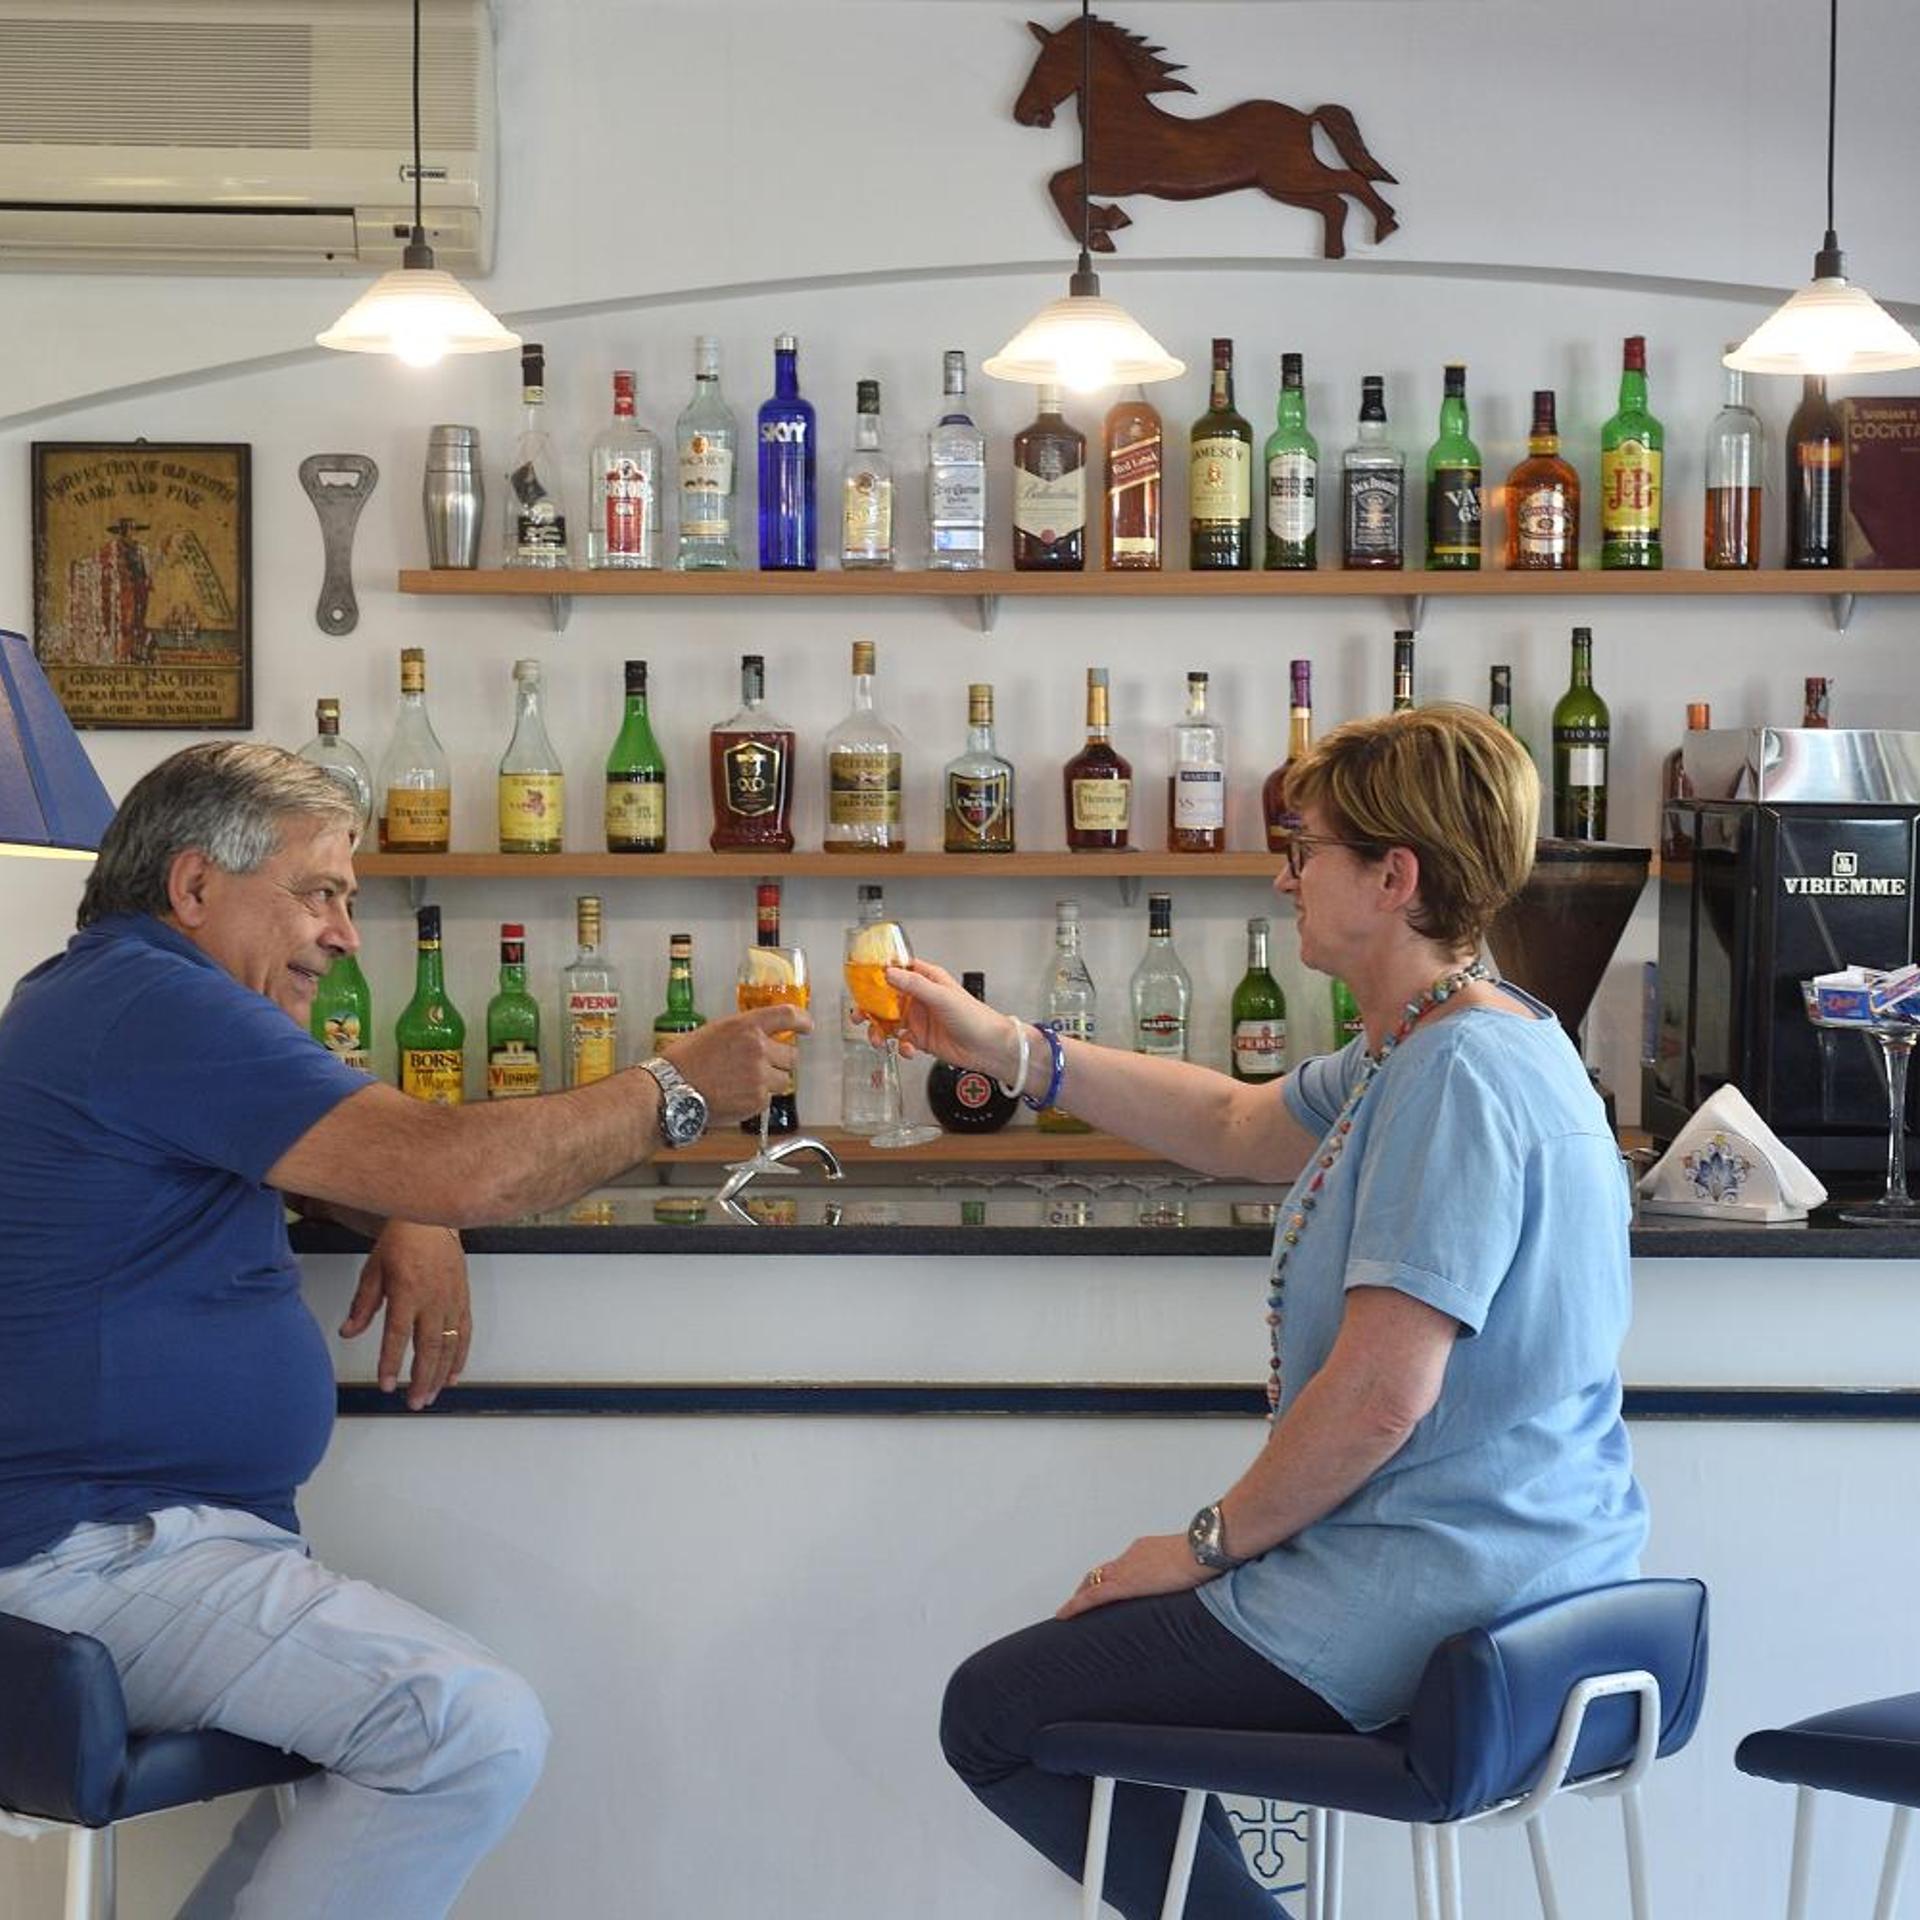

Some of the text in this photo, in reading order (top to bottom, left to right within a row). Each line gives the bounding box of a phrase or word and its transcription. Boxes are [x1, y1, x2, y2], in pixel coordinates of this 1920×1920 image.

[761, 421, 806, 443] SKYY
[1783, 877, 1906, 896] VIBIEMME
[570, 996, 618, 1009] AVERNA
